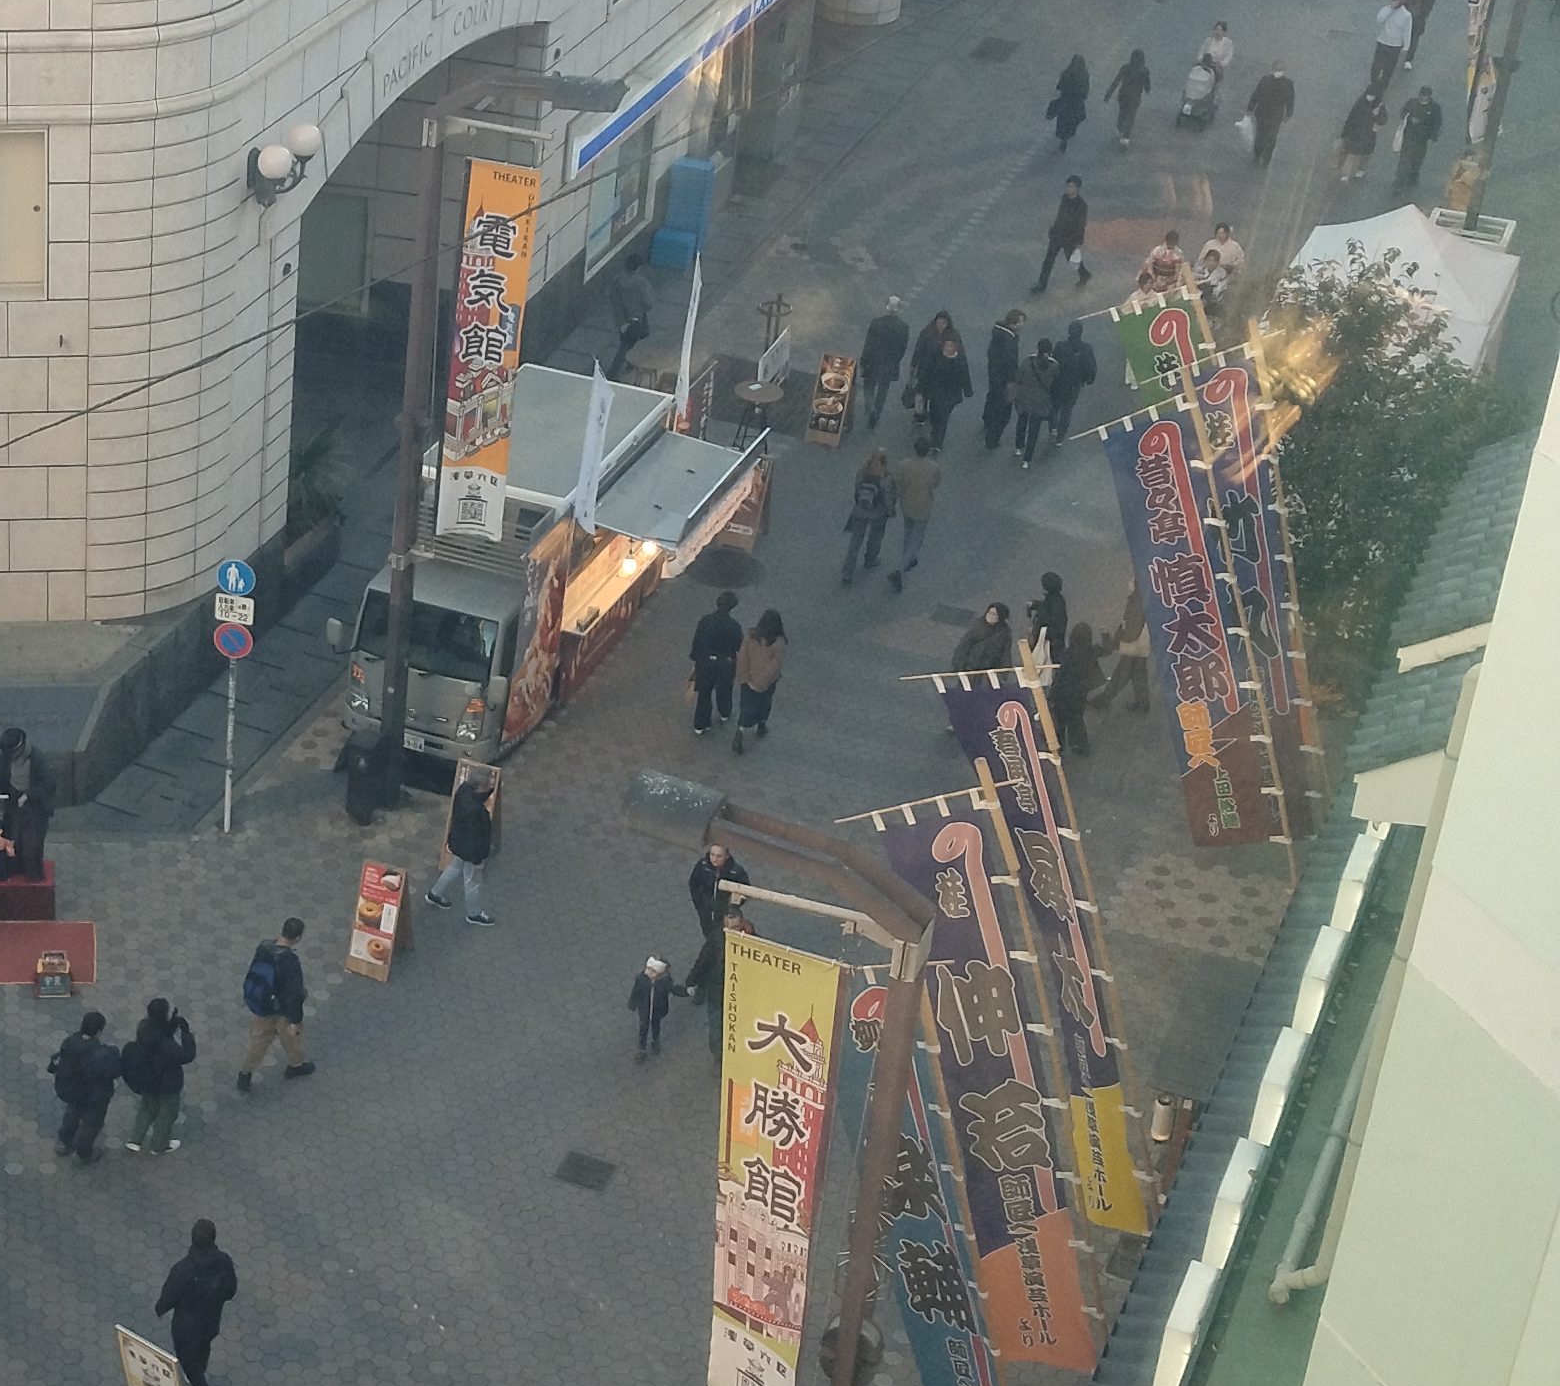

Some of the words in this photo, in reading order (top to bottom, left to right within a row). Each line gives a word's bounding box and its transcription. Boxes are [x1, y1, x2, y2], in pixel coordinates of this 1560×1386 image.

[382, 32, 434, 98] PACIFIC
[492, 170, 537, 188] THEATER
[520, 193, 536, 259] DEKIKAN
[461, 213, 517, 363] 電気館
[730, 942, 802, 976] THEATER
[727, 962, 739, 1054] TAISHOKAN
[743, 1012, 816, 1224] 大勝館
[1017, 1317, 1037, 1349] より
